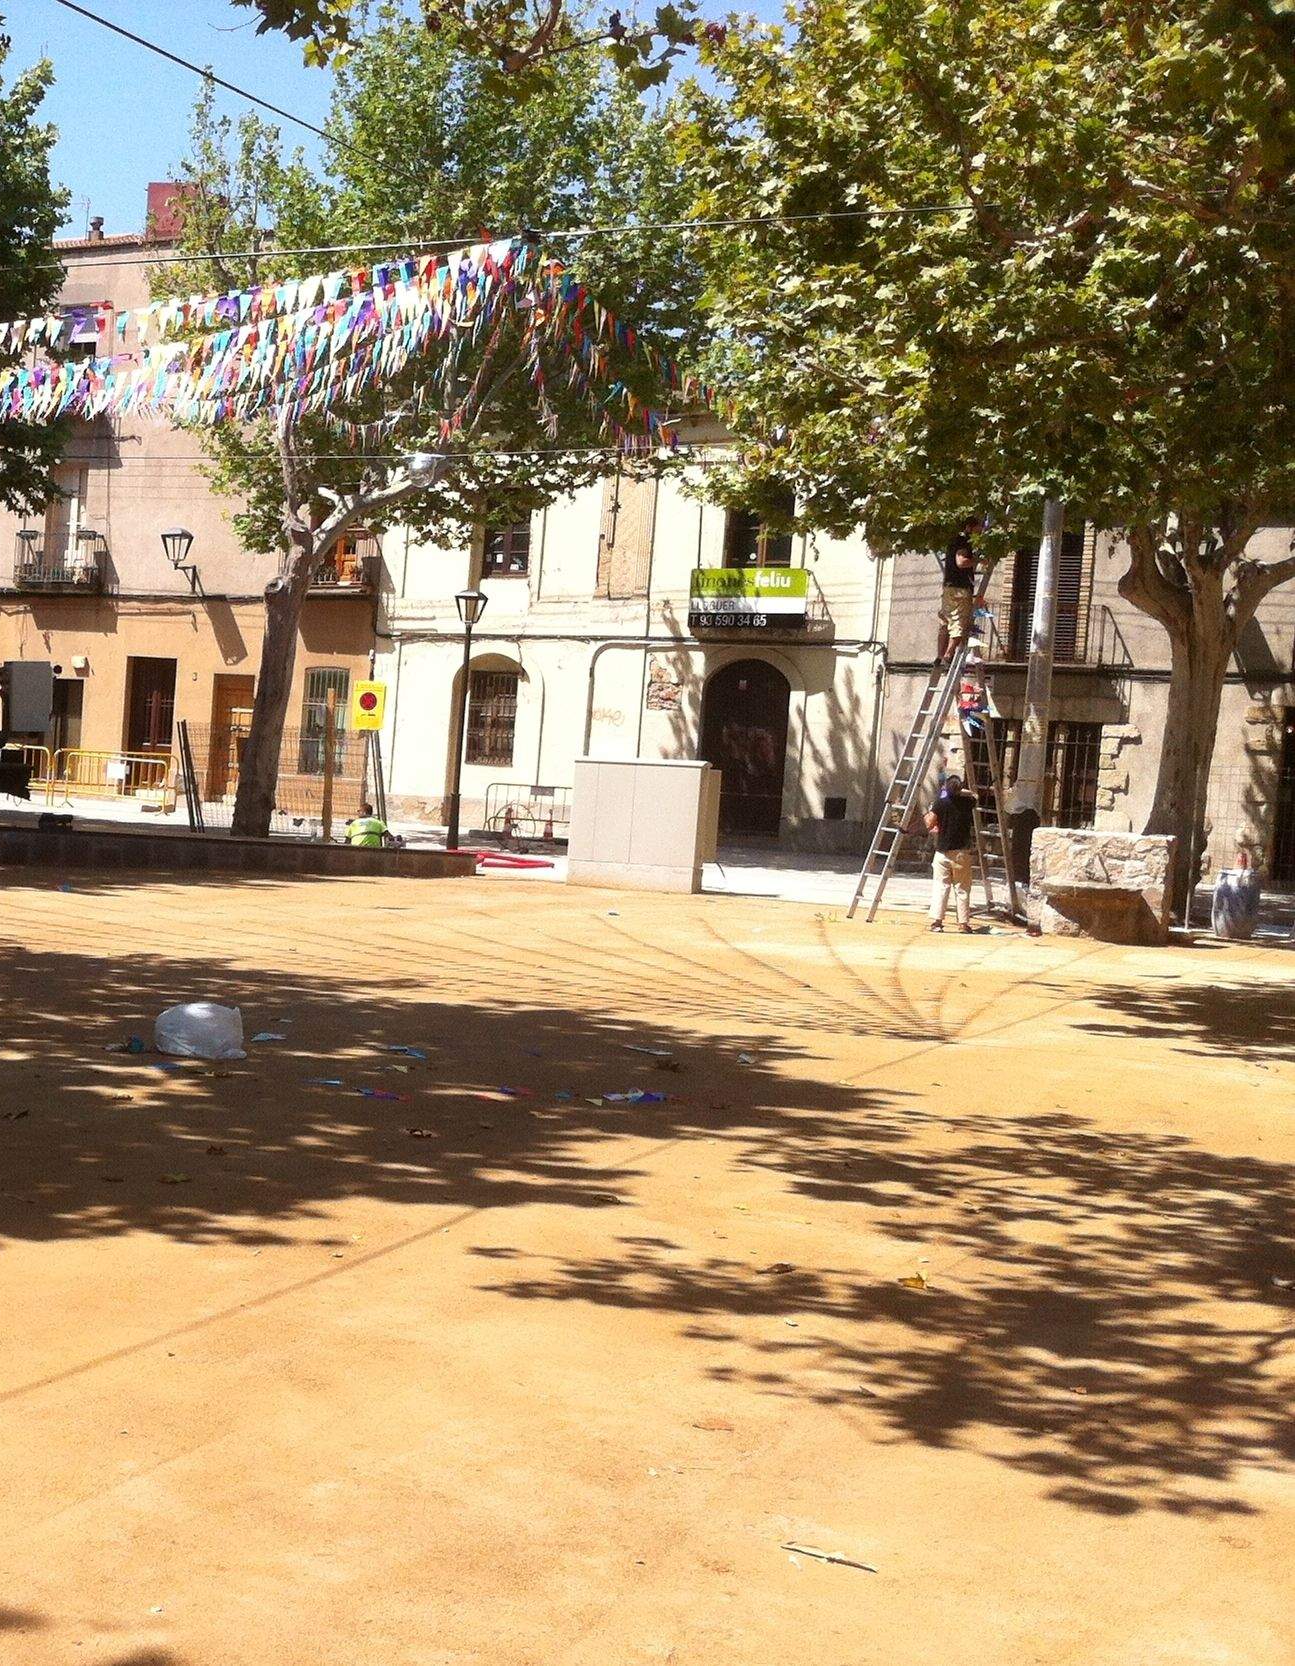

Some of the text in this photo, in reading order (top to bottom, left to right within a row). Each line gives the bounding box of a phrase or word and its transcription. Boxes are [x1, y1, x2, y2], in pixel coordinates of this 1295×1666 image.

[755, 571, 791, 588] feliu
[700, 615, 712, 626] 93
[715, 615, 735, 626] 590
[737, 615, 751, 626] 34
[753, 615, 767, 626] 65
